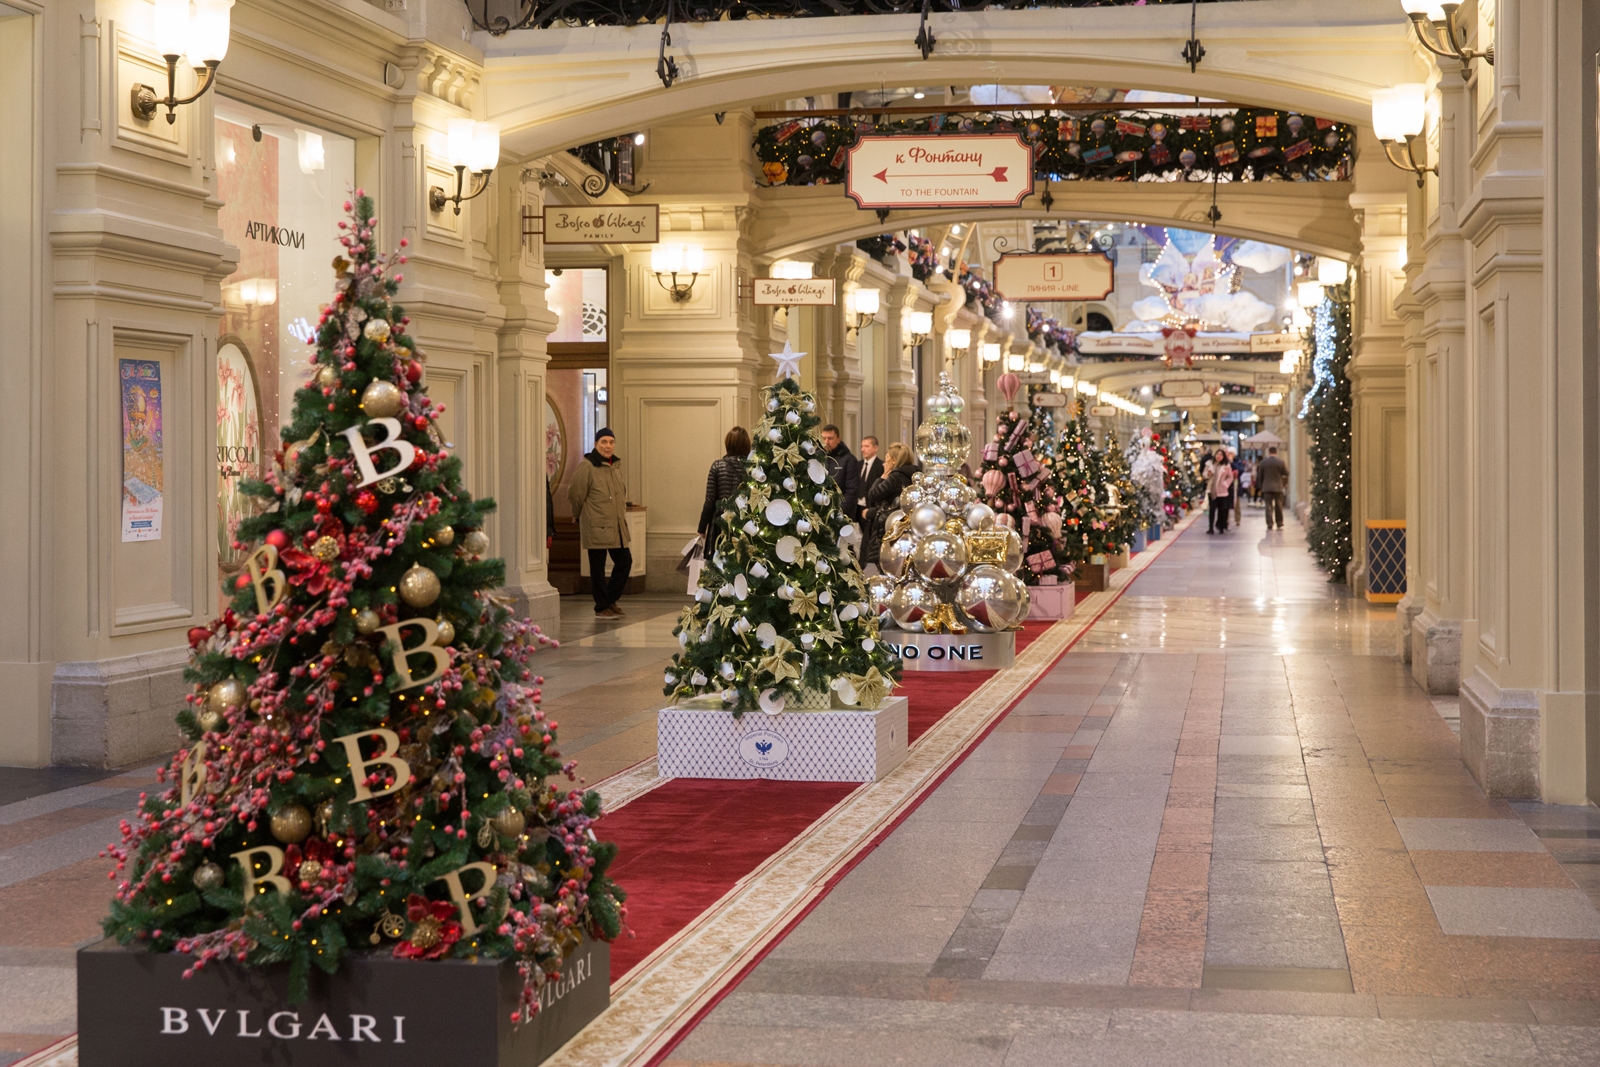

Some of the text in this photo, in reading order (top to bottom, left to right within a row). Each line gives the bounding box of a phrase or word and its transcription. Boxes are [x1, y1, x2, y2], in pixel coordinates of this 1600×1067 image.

[896, 146, 983, 167] к Фонтану
[900, 188, 979, 197] TO THE FOUNTAIN
[555, 213, 590, 232] Bosco
[245, 220, 305, 250] АРТИКОЛИ
[1050, 266, 1056, 278] 1
[1027, 284, 1079, 293] ЛИНИЯ LINE
[336, 417, 415, 488] B
[374, 617, 451, 694] B
[889, 643, 983, 660] NO ONE
[332, 728, 411, 804] B
[160, 1007, 406, 1044] BVLGARI
